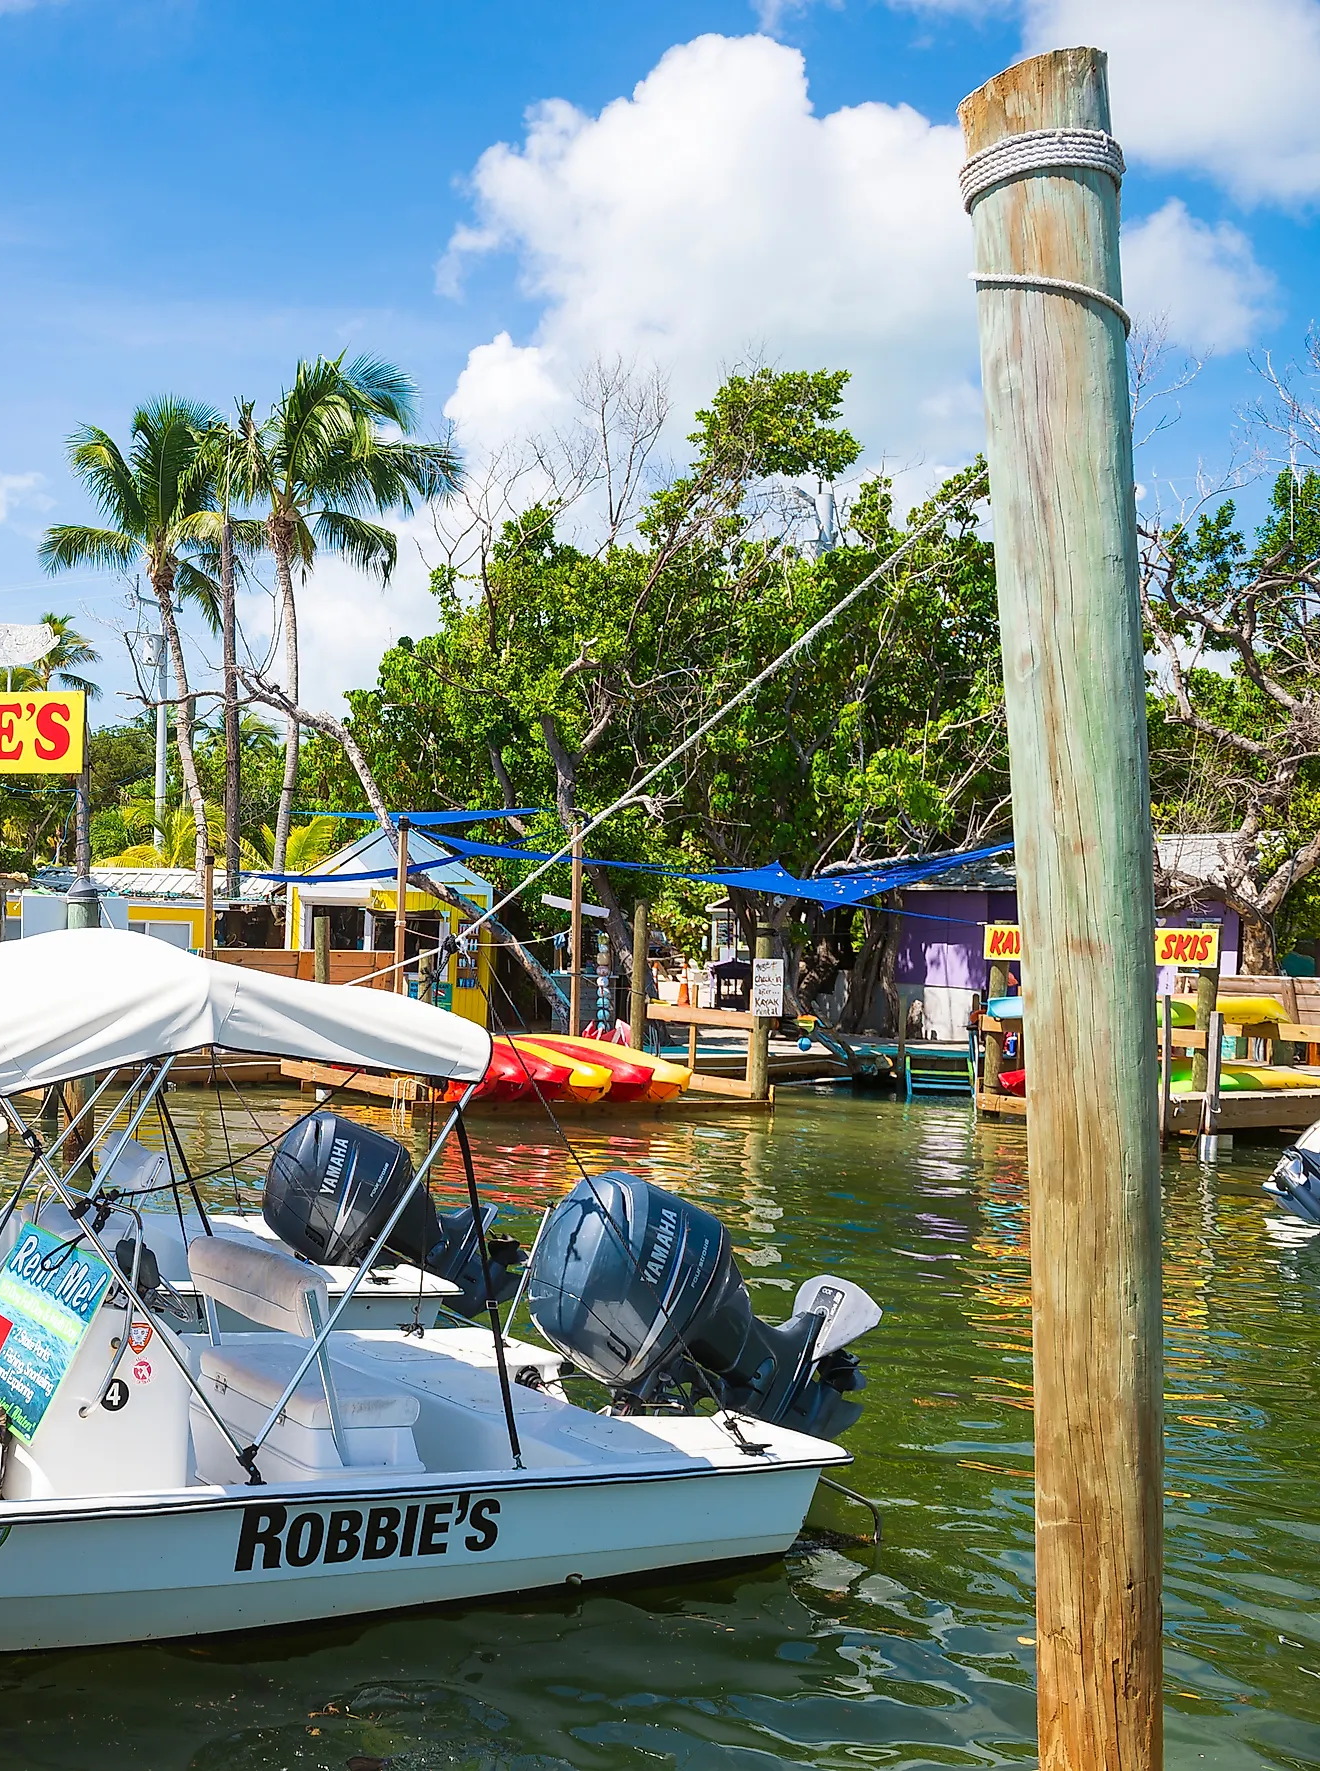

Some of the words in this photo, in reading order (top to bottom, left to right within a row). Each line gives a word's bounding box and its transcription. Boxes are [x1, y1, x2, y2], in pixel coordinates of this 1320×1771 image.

[1161, 933, 1213, 962] SKIS
[319, 1137, 350, 1195] YAMAHA
[8, 1233, 64, 1292] Rent
[53, 1260, 108, 1316] Me!
[639, 1207, 678, 1286] YAMAHA
[106, 1382, 121, 1407] 4
[234, 1493, 501, 1572] ROBBIE'S
